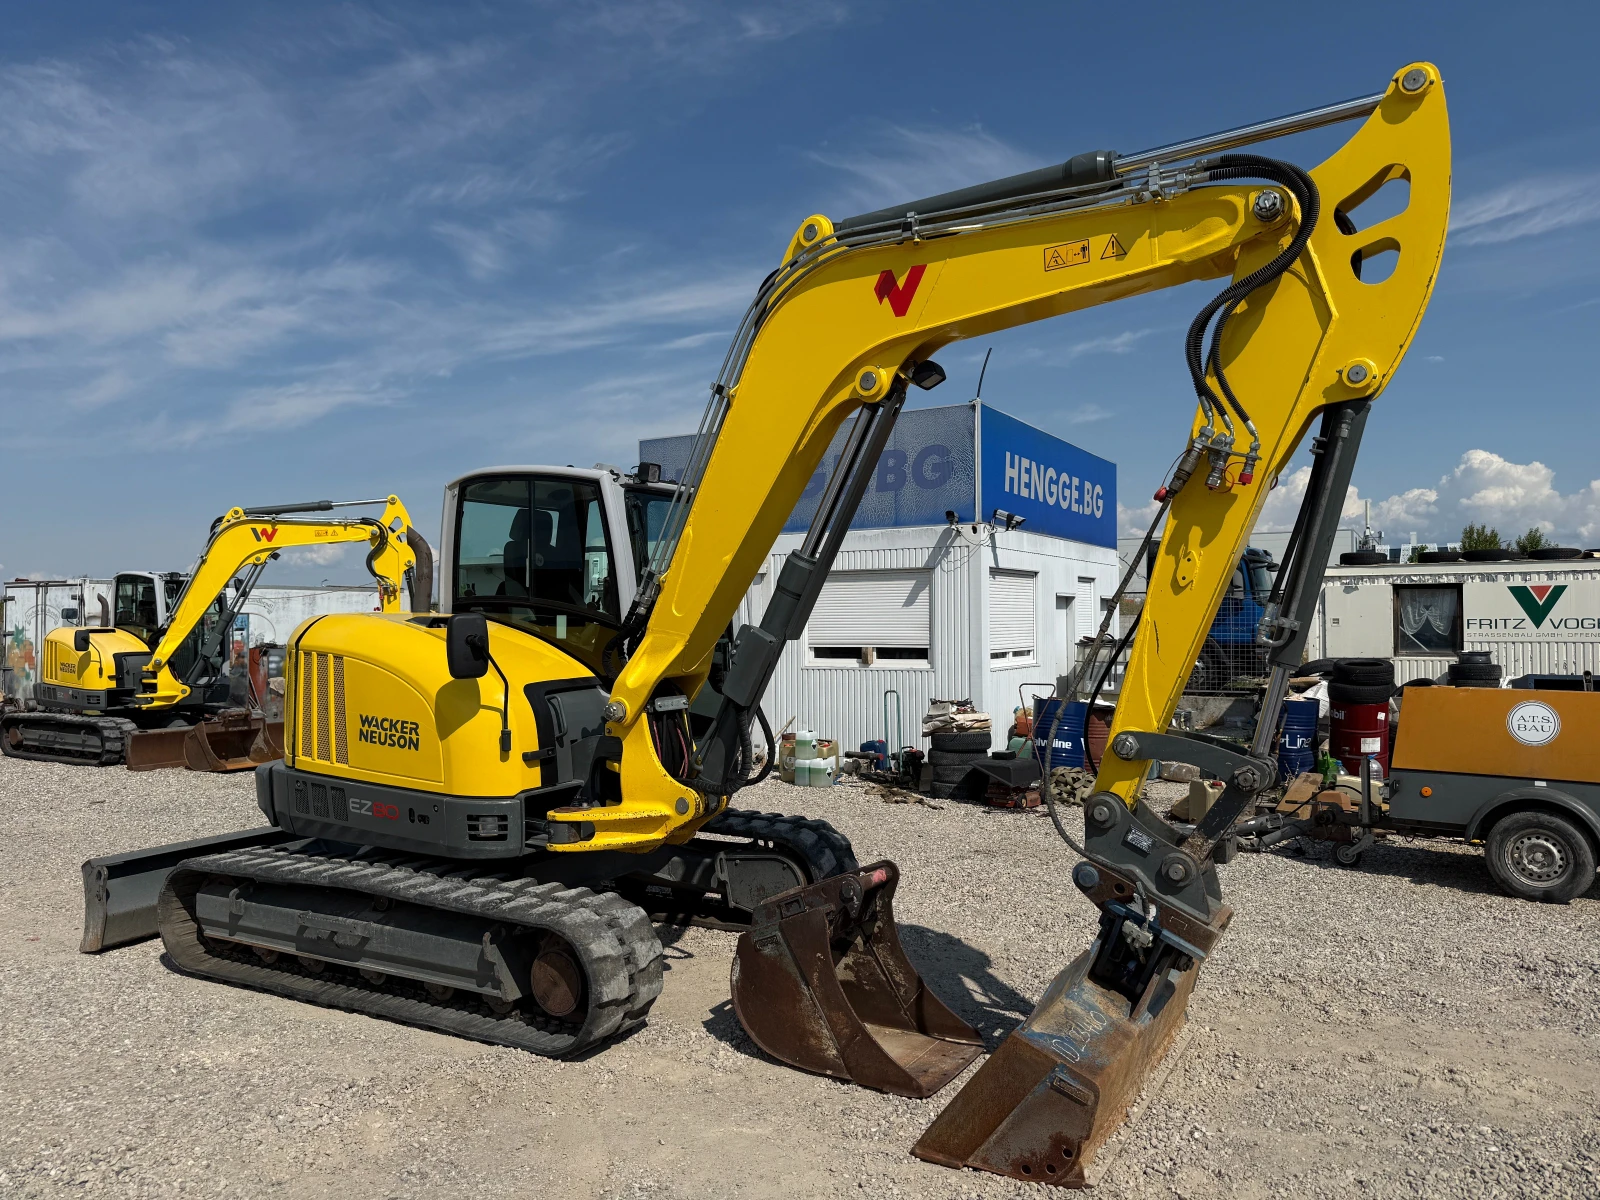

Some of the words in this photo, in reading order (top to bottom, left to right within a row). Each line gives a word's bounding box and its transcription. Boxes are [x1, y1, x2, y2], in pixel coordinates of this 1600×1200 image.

[1004, 451, 1104, 518] HENGGE.BG
[1466, 618, 1527, 629] FRITZ
[359, 714, 420, 736] WACKER
[1517, 715, 1553, 724] A.T.S.
[1517, 724, 1551, 732] BAU
[358, 728, 420, 751] NEUSON
[349, 798, 400, 820] EZ80
